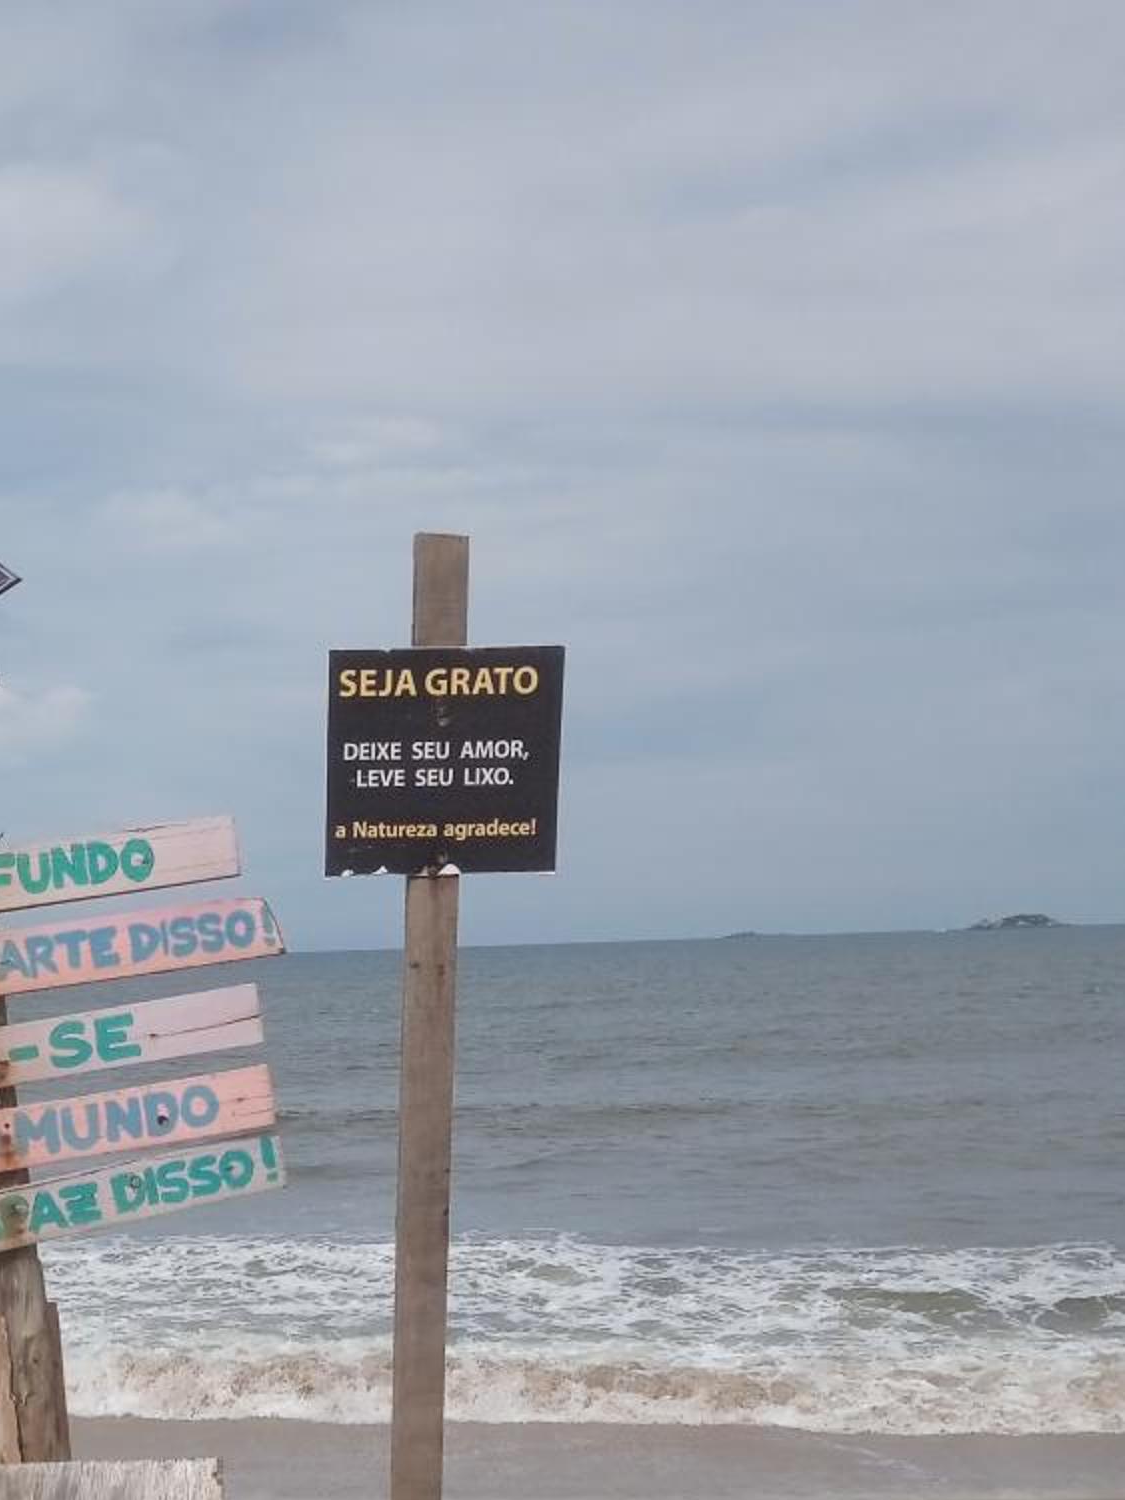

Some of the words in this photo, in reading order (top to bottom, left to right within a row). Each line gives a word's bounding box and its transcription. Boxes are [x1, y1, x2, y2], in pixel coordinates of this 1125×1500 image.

[339, 669, 417, 697] SEJA
[425, 666, 539, 696] GRATO
[343, 742, 402, 761] DEIXE
[411, 741, 450, 760] SEU
[460, 739, 529, 761] AMOR,
[356, 769, 406, 788] LEVE
[414, 769, 454, 787] SEU
[463, 767, 514, 786] LIXO.
[335, 824, 347, 838] a
[352, 821, 437, 839] Natureza
[443, 818, 537, 840] agradece!
[130, 911, 277, 964] DISSO!
[13, 1084, 221, 1156] MUNDO
[109, 1135, 280, 1211] DISSO!
